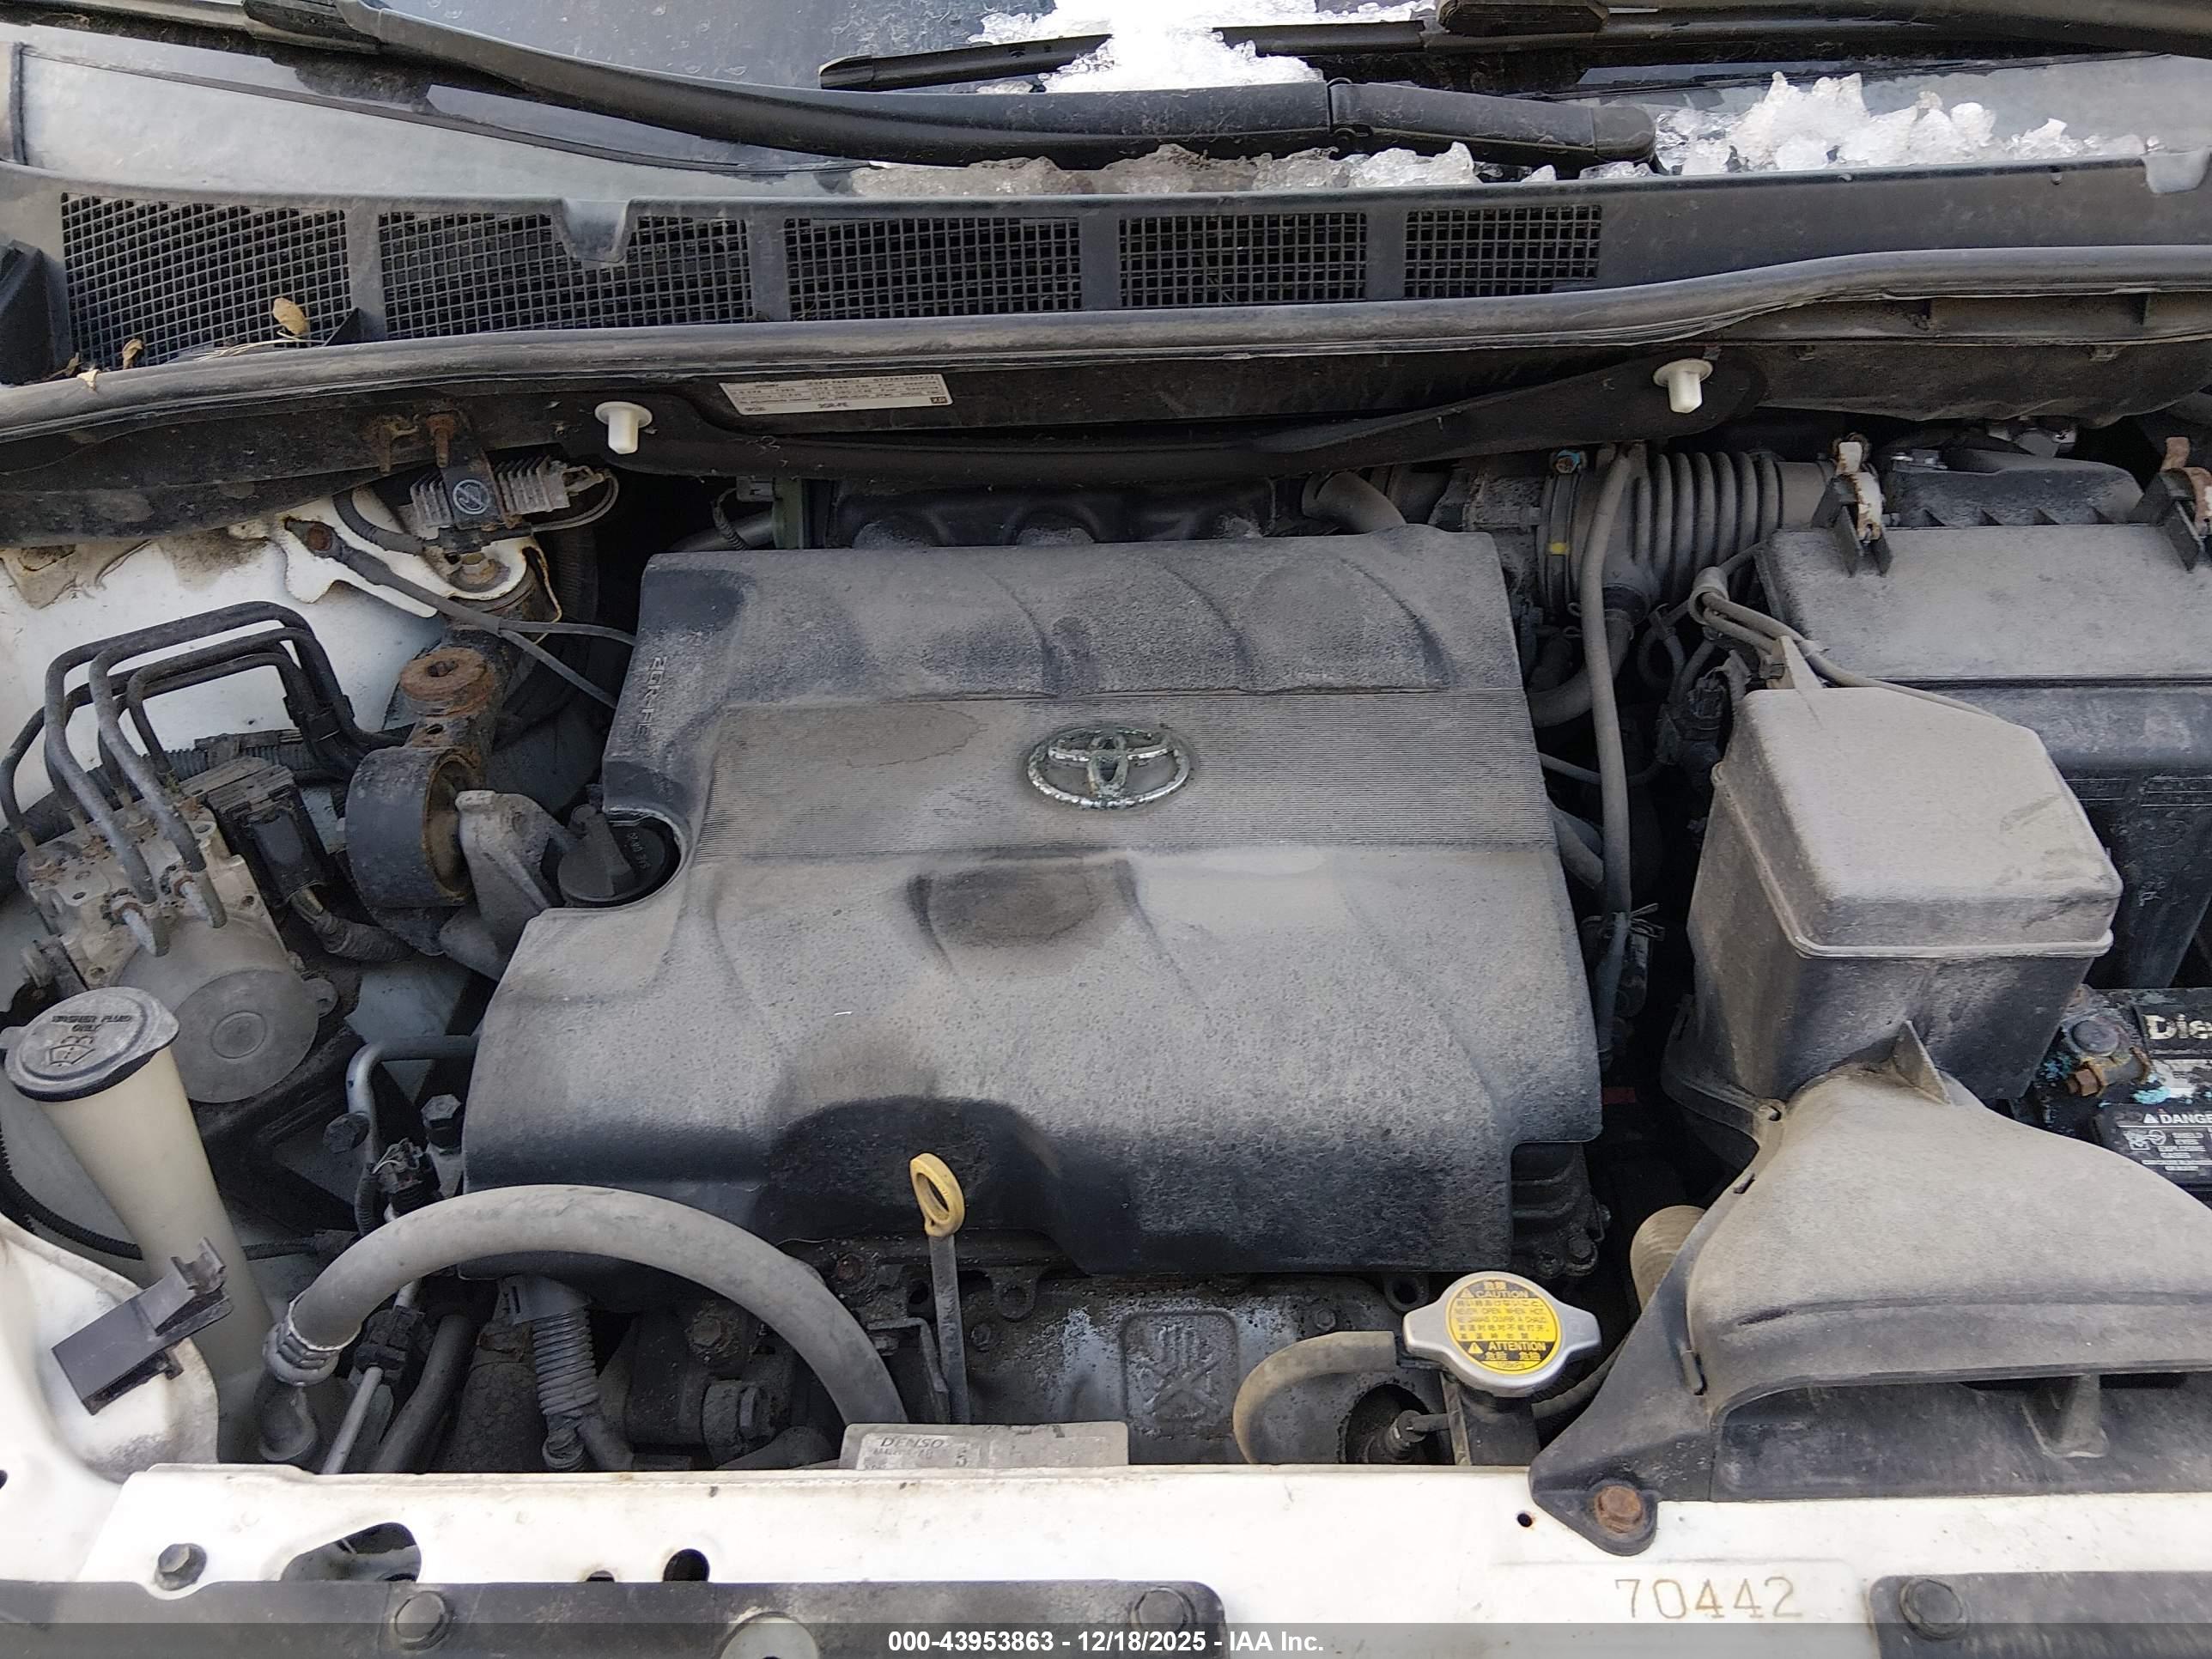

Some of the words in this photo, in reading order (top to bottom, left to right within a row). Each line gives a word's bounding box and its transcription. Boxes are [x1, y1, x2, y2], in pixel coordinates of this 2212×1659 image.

[1488, 1341, 1547, 1351] ATTENTION
[880, 1436, 945, 1449] DENSO
[1613, 1576, 1803, 1620] 70442
